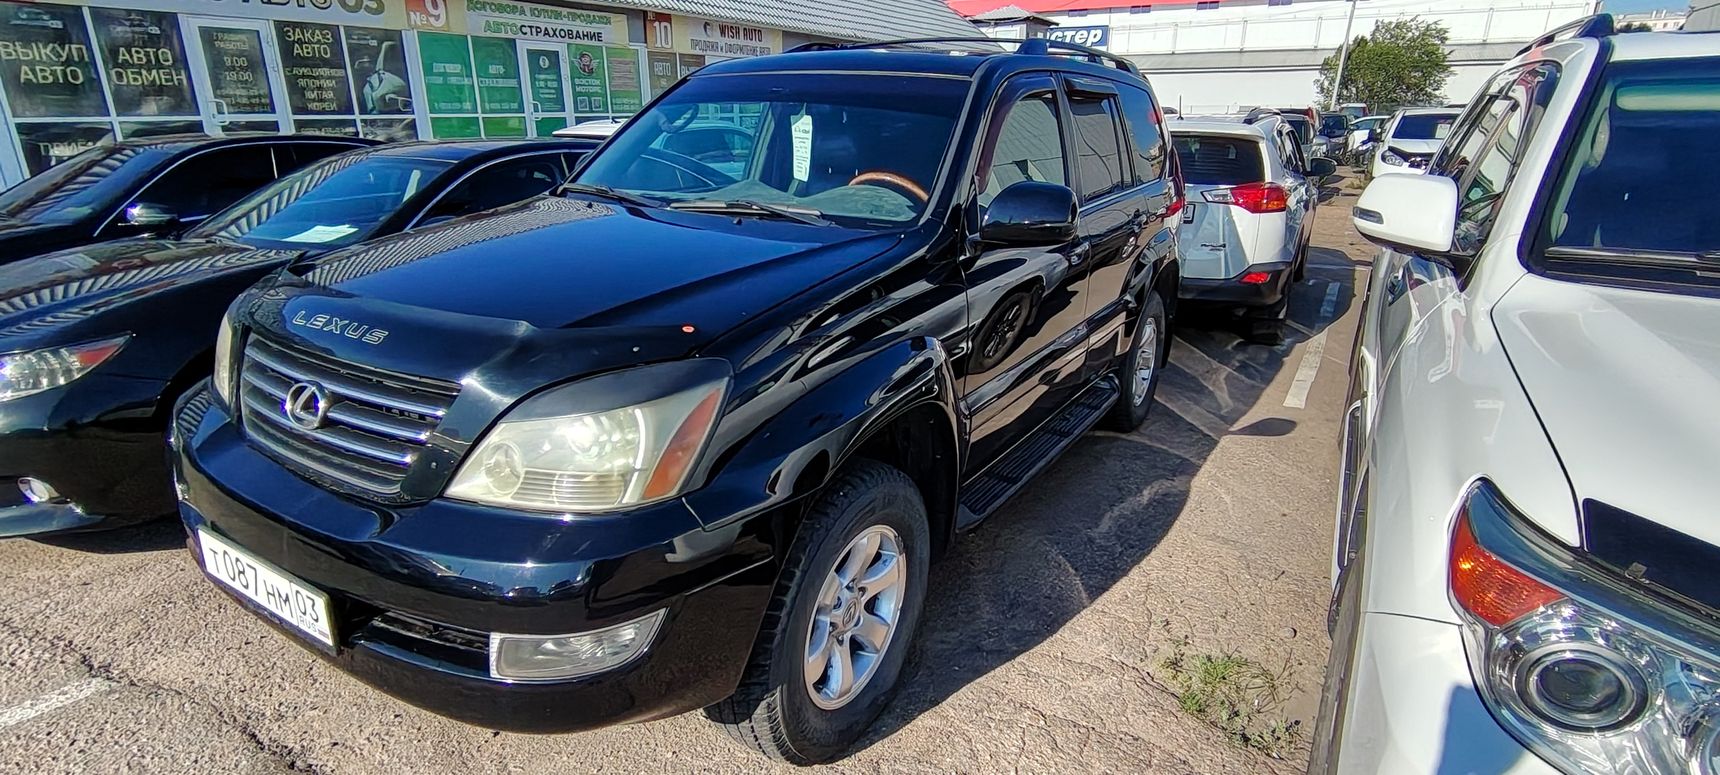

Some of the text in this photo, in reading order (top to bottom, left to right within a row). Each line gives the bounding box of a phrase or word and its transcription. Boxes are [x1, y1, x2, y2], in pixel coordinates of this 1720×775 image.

[283, 27, 333, 43] ЗАКАЗ
[484, 20, 603, 42] АВТОСТРАХОВАНИЕ
[653, 21, 672, 49] 10
[718, 23, 763, 42] WISH AUTO
[1046, 29, 1103, 47] стер
[0, 41, 89, 62] ВЫКУП
[118, 47, 173, 66] АВТО
[293, 44, 331, 58] АВТО
[20, 65, 84, 85] АВТО
[110, 67, 187, 86] ОБМЕН
[292, 310, 389, 345] LEXUS
